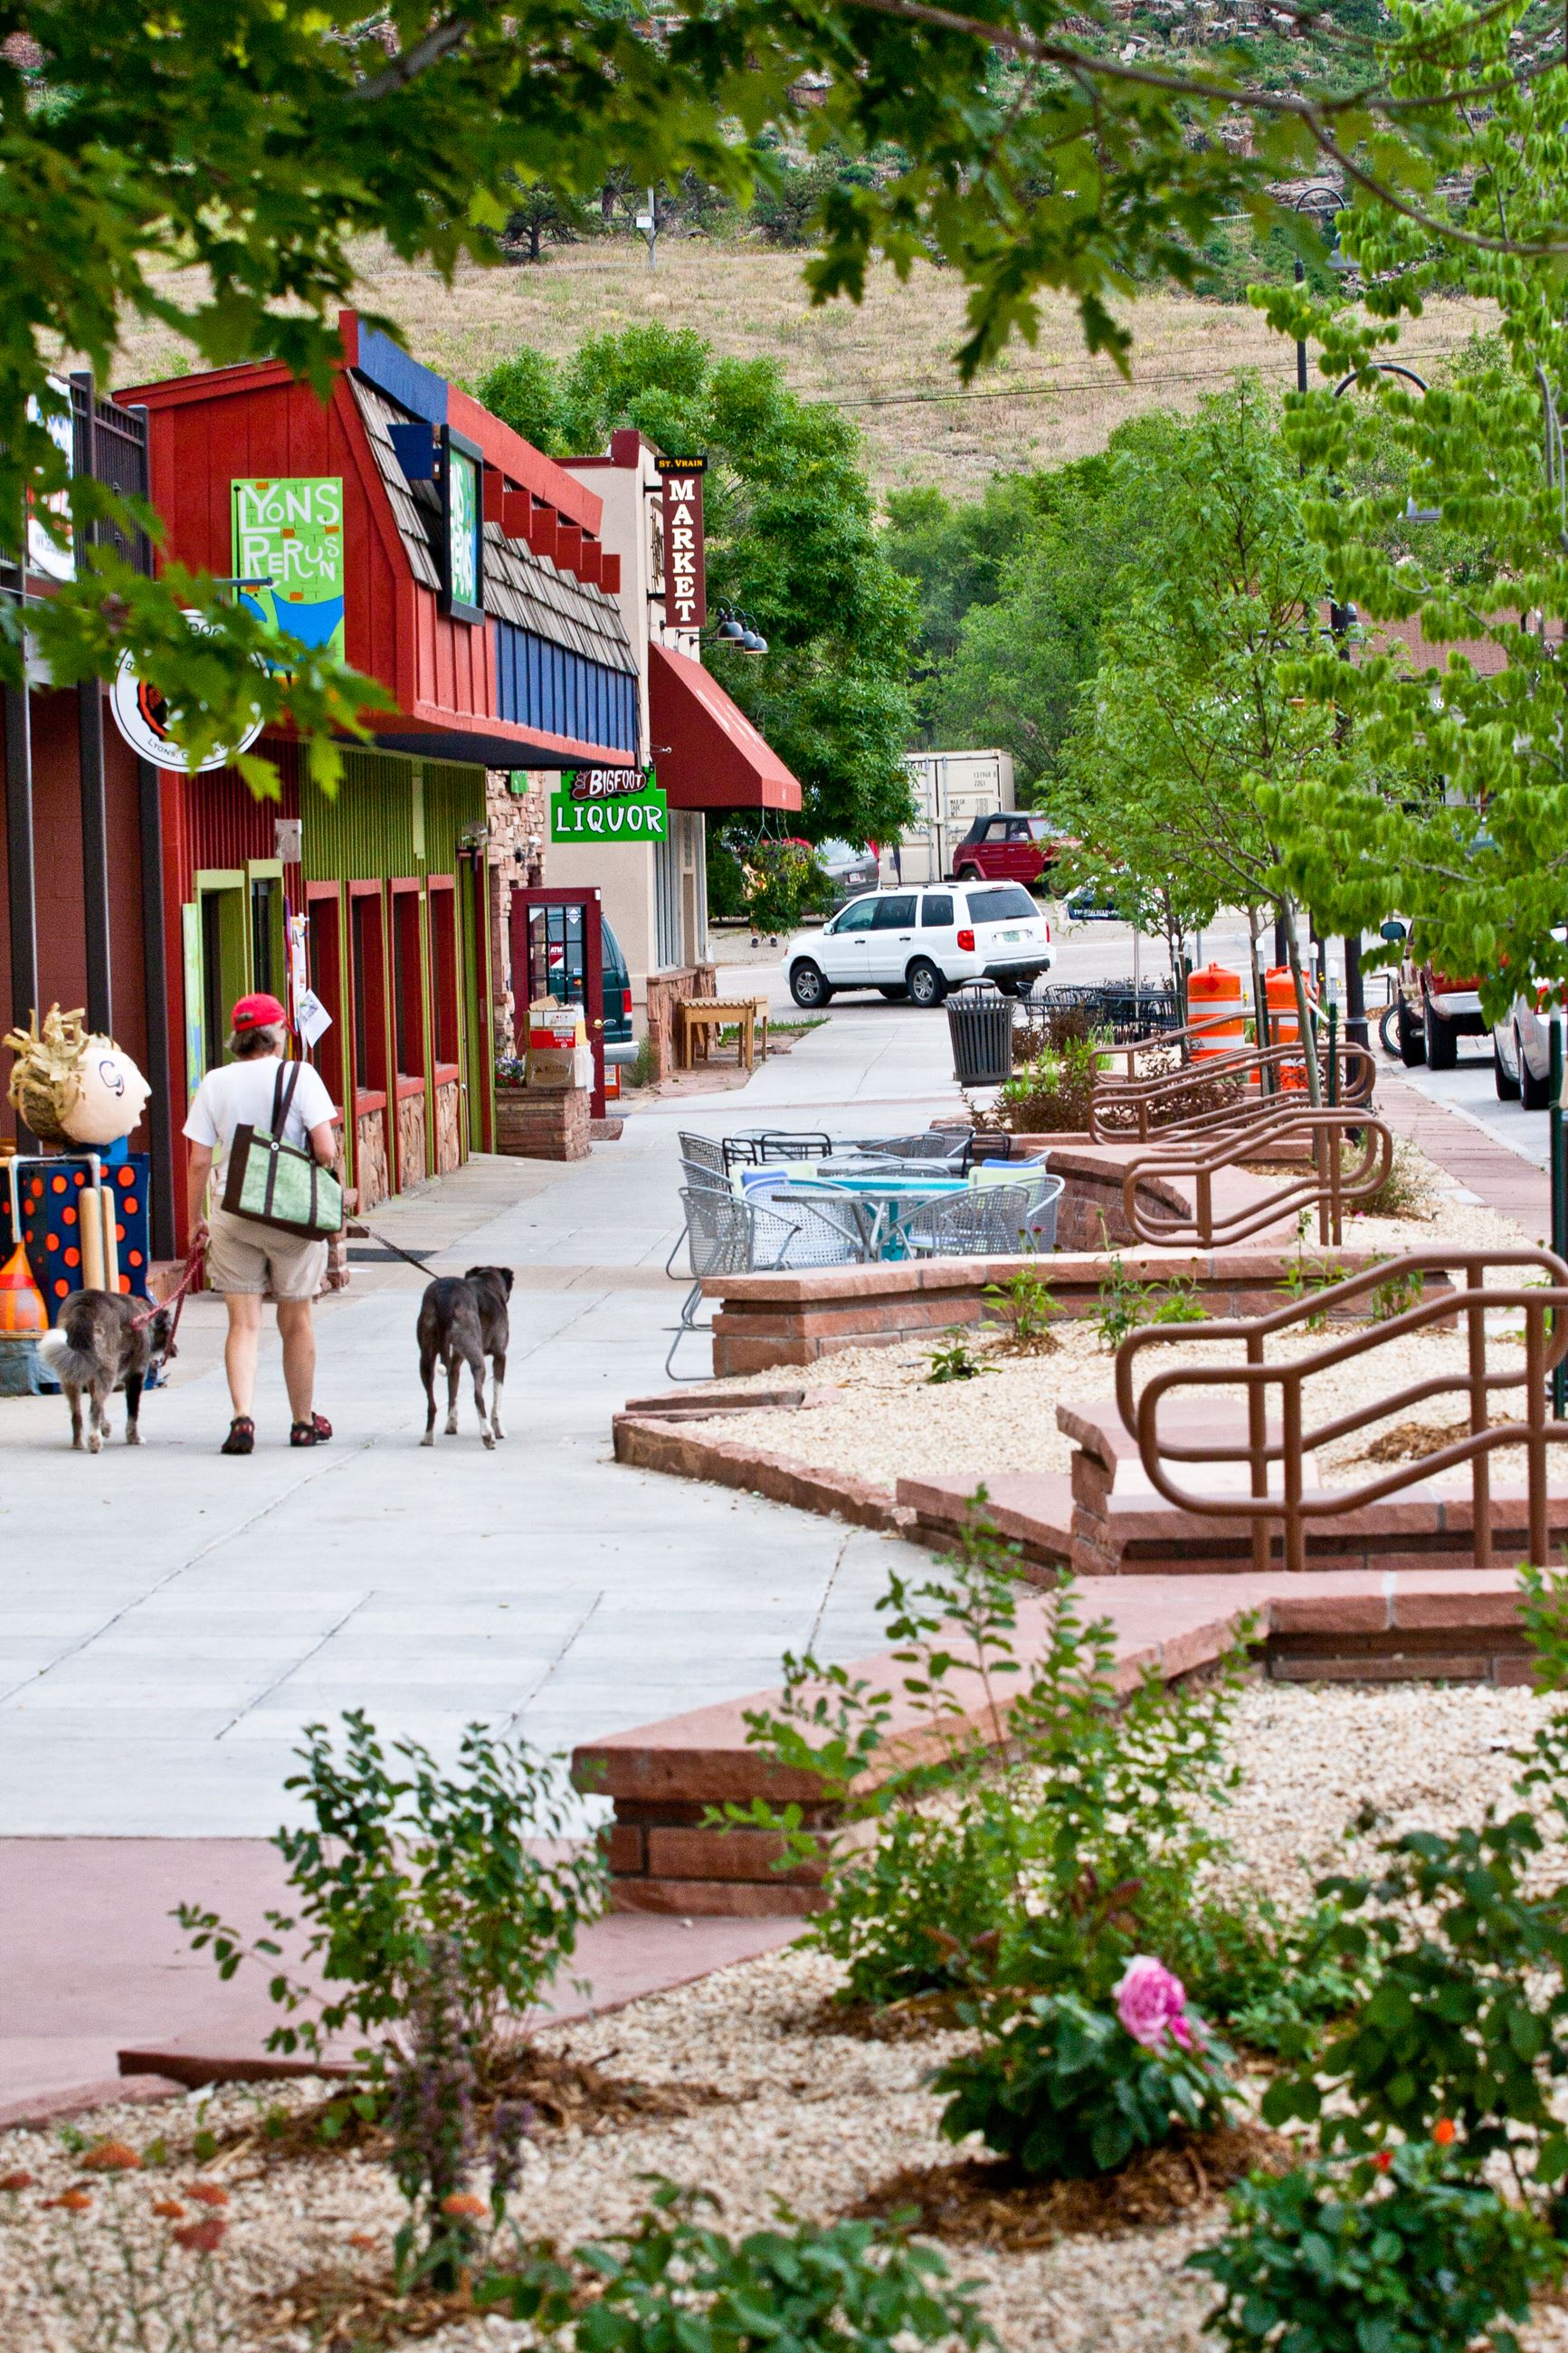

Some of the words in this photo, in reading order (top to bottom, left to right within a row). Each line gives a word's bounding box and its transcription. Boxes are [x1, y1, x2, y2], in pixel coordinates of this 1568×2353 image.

[675, 459, 703, 468] VRAIN
[668, 479, 696, 622] MARKET
[589, 769, 643, 795] BIGFOOT
[556, 805, 663, 834] LIQUOR
